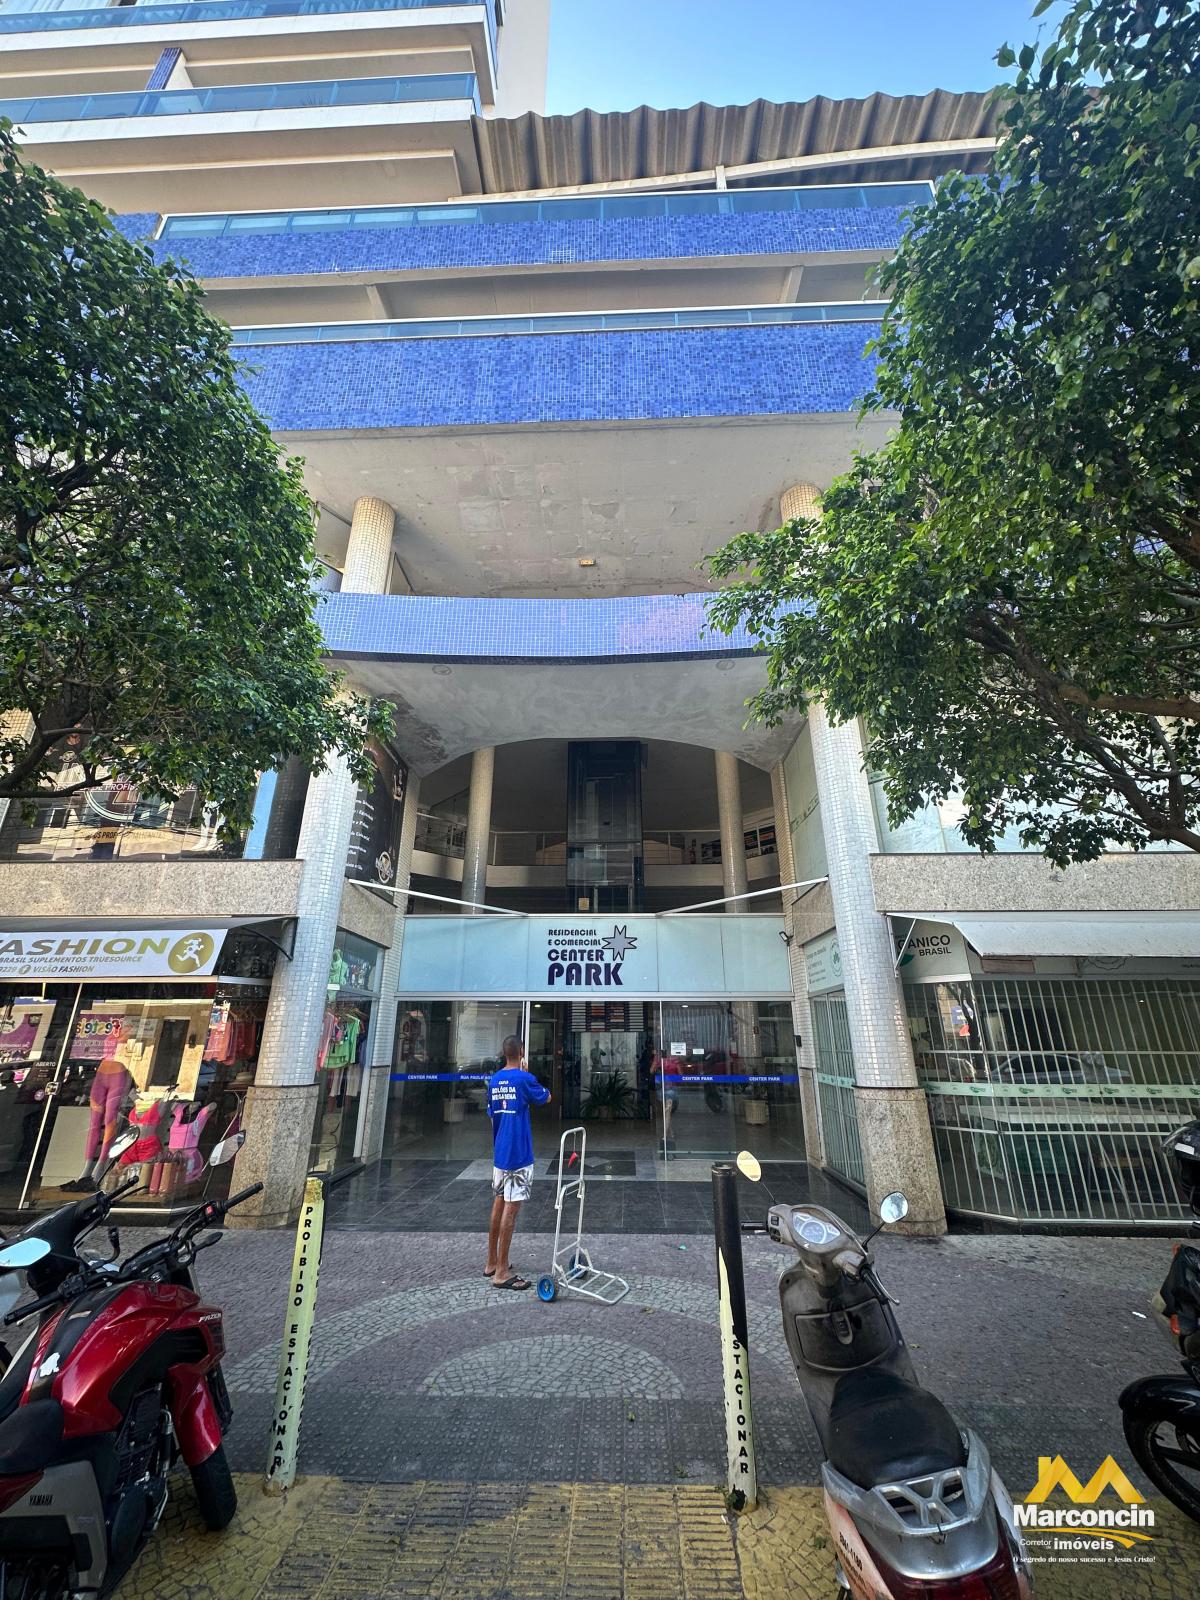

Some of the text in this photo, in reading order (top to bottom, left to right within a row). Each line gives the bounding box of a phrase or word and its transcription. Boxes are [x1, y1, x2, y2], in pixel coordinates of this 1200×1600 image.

[0, 937, 170, 956] ASHION
[918, 947, 952, 957] BRASIL
[28, 955, 87, 963] SUPLEMENTOS
[88, 955, 142, 963] TRUESOURCE
[547, 948, 605, 962] CENTER
[57, 965, 95, 973] FASHION
[547, 962, 624, 986] PARK
[273, 1206, 314, 1468] PROIBIDO ESTACIONAR
[29, 1494, 53, 1506] YAMAHA
